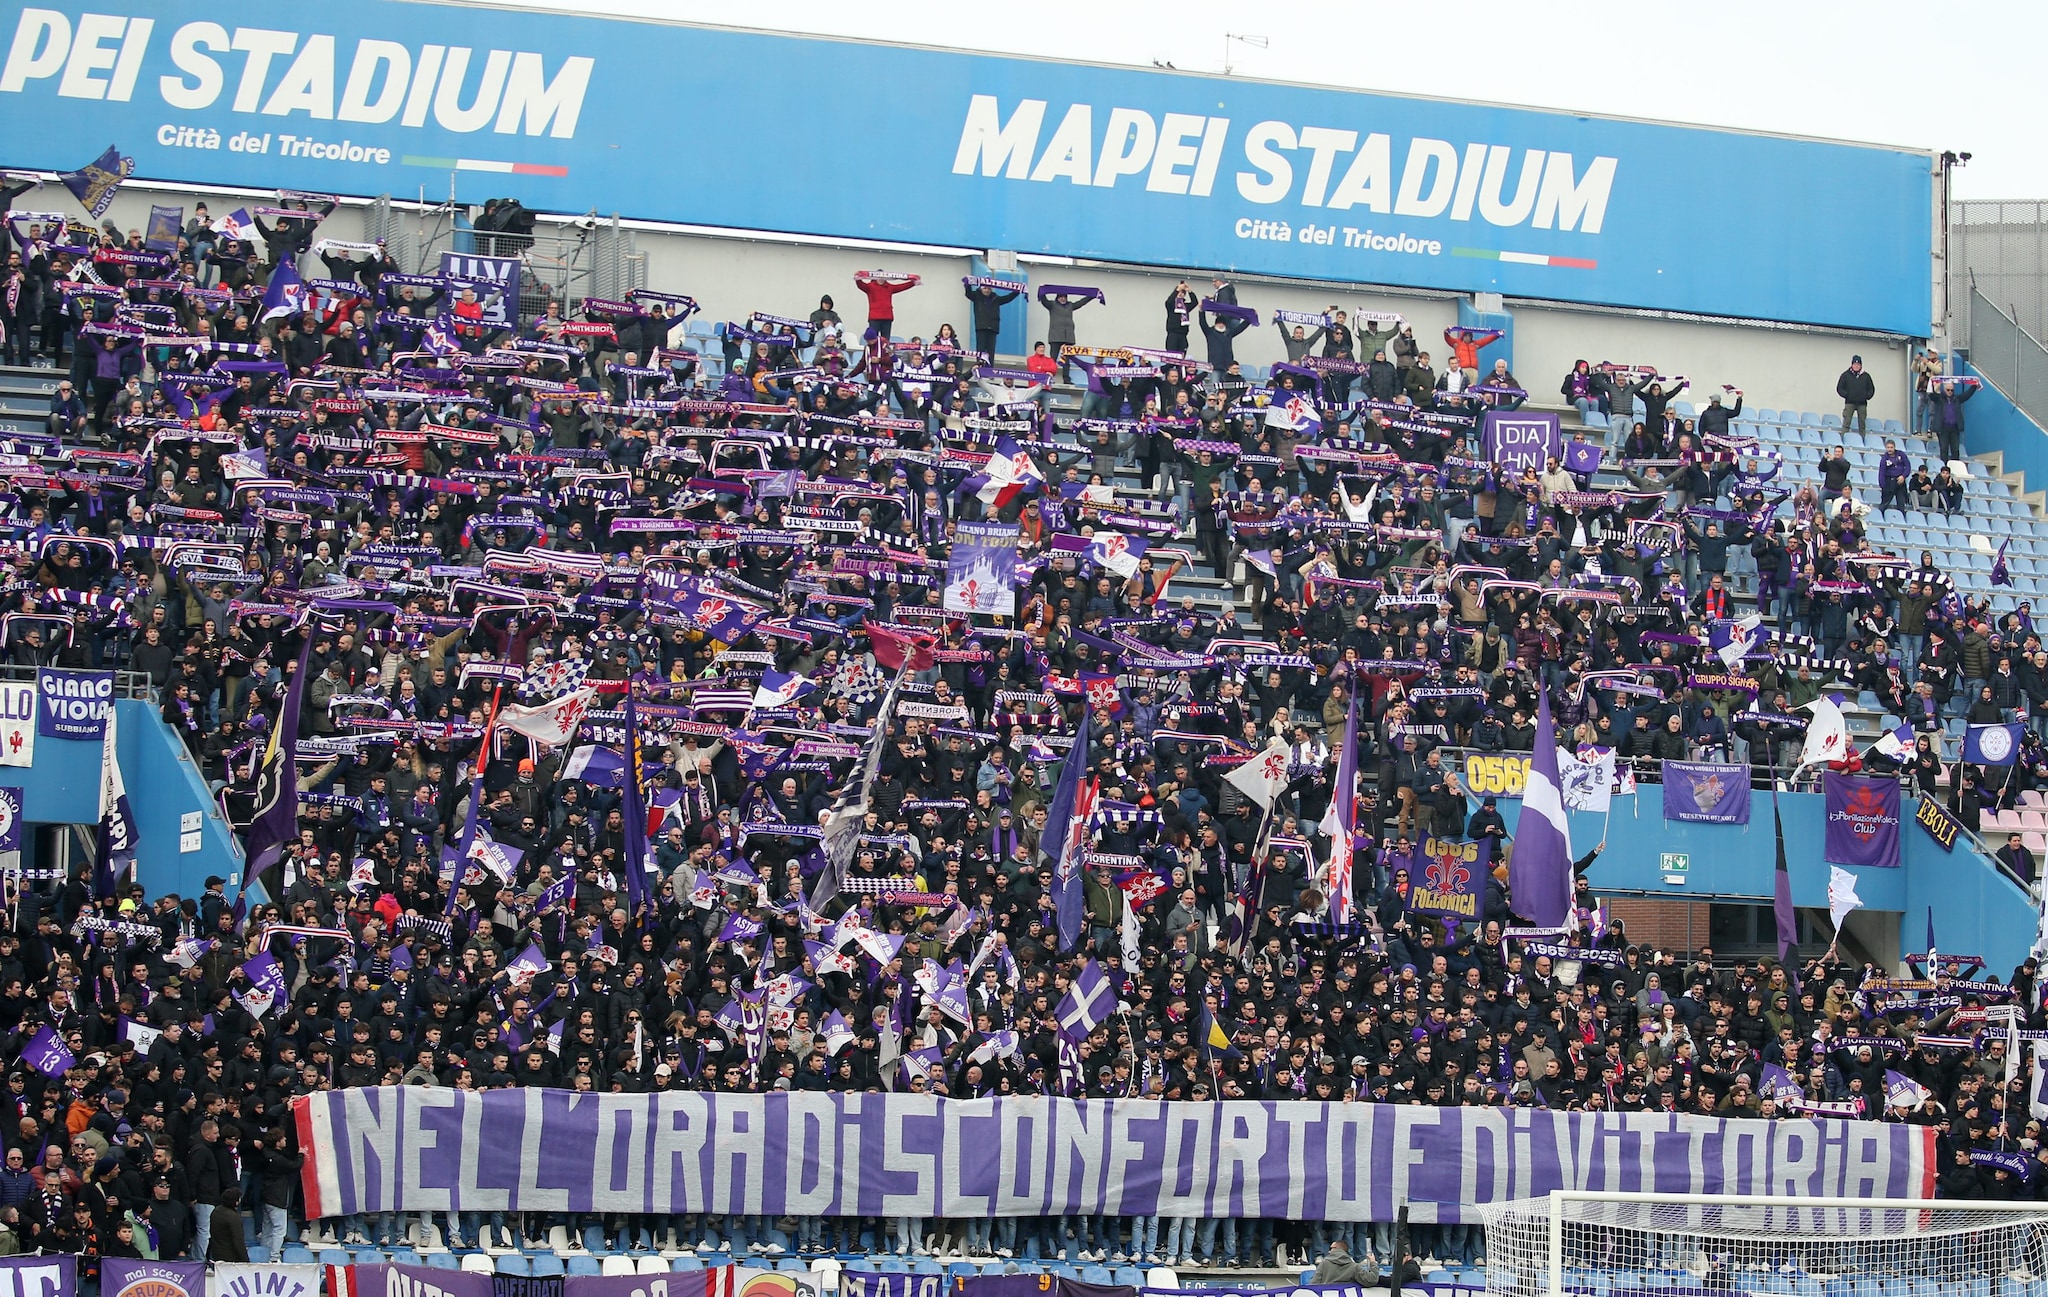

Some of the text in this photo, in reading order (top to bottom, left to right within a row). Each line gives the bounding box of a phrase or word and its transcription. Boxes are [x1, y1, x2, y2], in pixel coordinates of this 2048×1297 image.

[160, 21, 595, 140] STADIUM
[157, 124, 390, 166] Città del Tricolore
[952, 94, 1618, 235] MAPEI STADIUM
[1234, 217, 1442, 257] Città del Tricolore
[110, 253, 159, 264] FIORENTINA
[449, 256, 513, 280] UV
[382, 273, 446, 286] ULTRAS
[444, 271, 509, 287] ULTRAS
[979, 277, 1022, 290] ALTERATI
[592, 301, 634, 313] FIORENTINA
[122, 315, 183, 334] FIORENTINA
[1280, 312, 1327, 326] FIORENTINA
[1063, 345, 1134, 358] RVA FIESOL
[619, 367, 668, 377] FIORENTINA
[908, 373, 954, 383] FIORENTINA
[174, 375, 226, 385] FIORENTINA
[520, 377, 564, 390] FIORENTINA
[1366, 401, 1410, 412] FIORENTINA
[1505, 428, 1540, 444] DIA
[1240, 454, 1281, 462] FIORENTINA
[1508, 452, 1537, 468] HN
[278, 492, 319, 501] FIORENTINA
[789, 505, 842, 517] FIORENTINA
[786, 518, 860, 529] JUVE MERDA
[1049, 512, 1067, 528] 13
[1322, 521, 1369, 530] FIORENTINA
[608, 576, 636, 584] FIRENZE
[729, 575, 774, 598] FIORENTINA
[590, 596, 629, 605] FIORENTINA
[895, 606, 943, 617] COLLETTIVO
[1243, 654, 1309, 668] OLLETTIV
[479, 664, 524, 676] FIORETINA
[728, 669, 764, 678] FIORENT
[42, 674, 113, 698] GIANO
[1695, 674, 1727, 687] GRUPPO
[0, 688, 33, 721] LO
[47, 697, 110, 721] VIOLA
[1168, 705, 1217, 714] FIORENTINA
[587, 709, 644, 720] COLLETTO
[55, 723, 99, 733] SUBBIANO
[421, 721, 445, 729] BABBO
[594, 726, 659, 746] FIOREINA
[815, 746, 851, 754] FIORENTINA
[1854, 822, 1876, 834] Club
[1916, 798, 1957, 847] EBOLI
[1084, 853, 1139, 865] FIORENTINA
[547, 886, 564, 902] 13
[1410, 885, 1475, 916] FOLLONICA
[1530, 942, 1618, 962] 1965 2025
[1950, 978, 2008, 993] FIORENTINA
[548, 1031, 562, 1044] ACF
[1842, 1037, 1901, 1048] FIORENTINA
[43, 1051, 60, 1072] 13
[342, 1085, 766, 1216] NELL'ORA
[884, 1093, 1376, 1223] SCONFORTO
[1392, 1104, 1441, 1225] E
[1969, 1150, 1994, 1162] vanti
[124, 1266, 186, 1285] mai scesi
